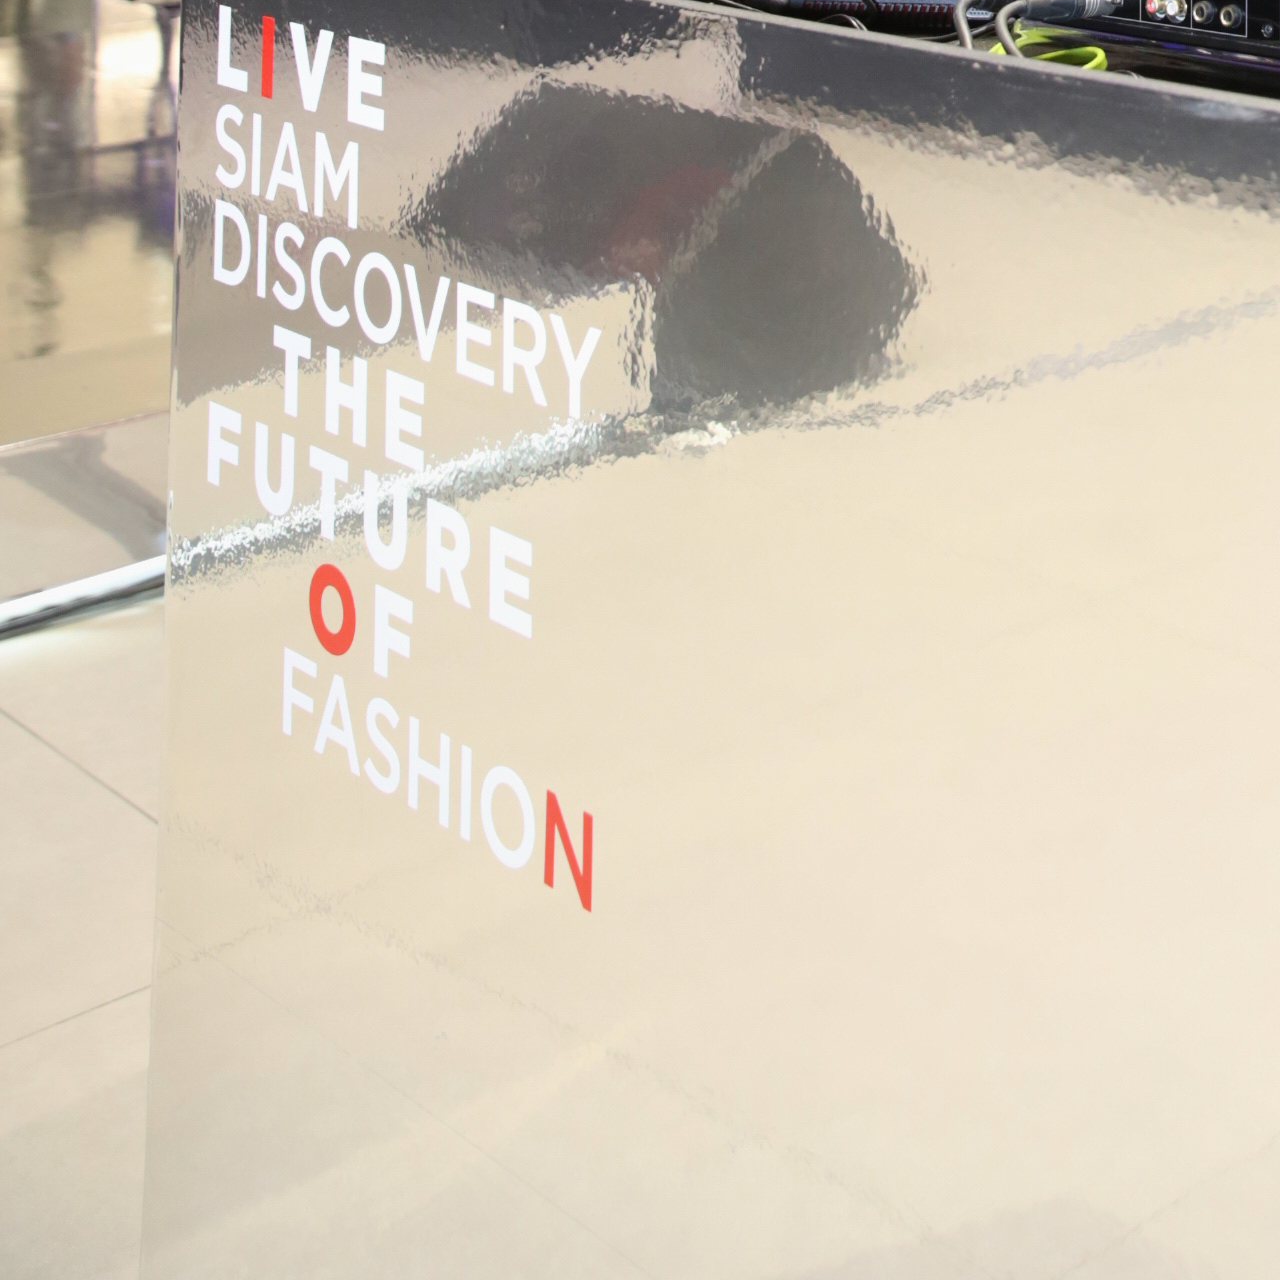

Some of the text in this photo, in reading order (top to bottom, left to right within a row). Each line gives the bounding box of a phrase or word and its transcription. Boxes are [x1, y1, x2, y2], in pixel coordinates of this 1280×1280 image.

[216, 4, 386, 132] LIVE
[214, 103, 359, 230] SIAM
[213, 199, 601, 419] DISCOVERY
[272, 324, 425, 469] THE
[206, 401, 533, 640] FUTURE
[308, 563, 413, 679] OF
[282, 646, 594, 913] FASHION
